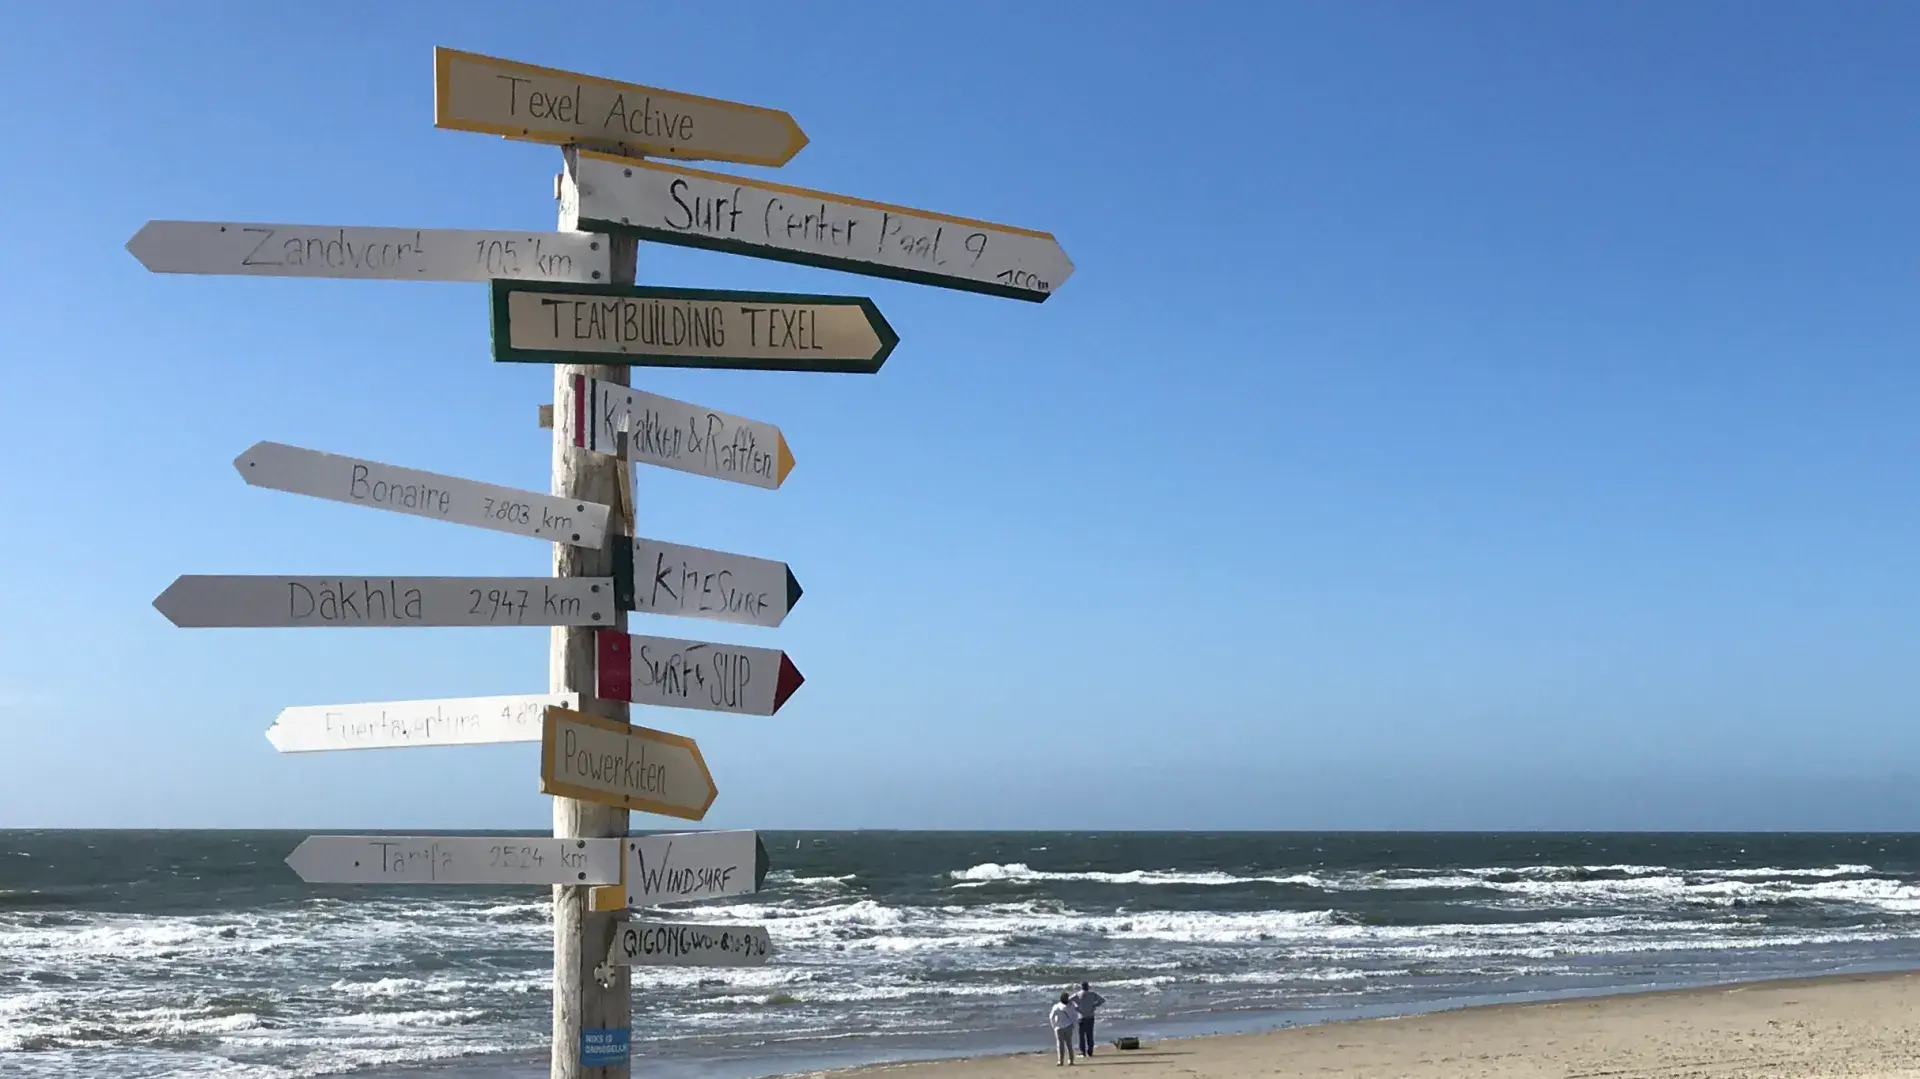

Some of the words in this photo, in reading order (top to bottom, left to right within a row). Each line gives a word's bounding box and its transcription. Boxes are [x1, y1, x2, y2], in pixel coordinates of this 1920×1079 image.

[496, 74, 584, 126] Texel
[604, 93, 694, 141] Active
[664, 179, 743, 232] Surf
[764, 197, 860, 246] Center
[964, 232, 988, 268] 9
[241, 228, 427, 272] Zandvoort
[476, 239, 521, 275] 105
[535, 238, 572, 276] km
[740, 306, 824, 350] TEXEL
[350, 463, 450, 515] Bonaire
[542, 506, 573, 531] km
[543, 584, 581, 617] km
[709, 651, 752, 709] SUP
[564, 727, 667, 796] Powerkiten
[560, 843, 588, 870] km
[637, 841, 738, 896] WINDSURF
